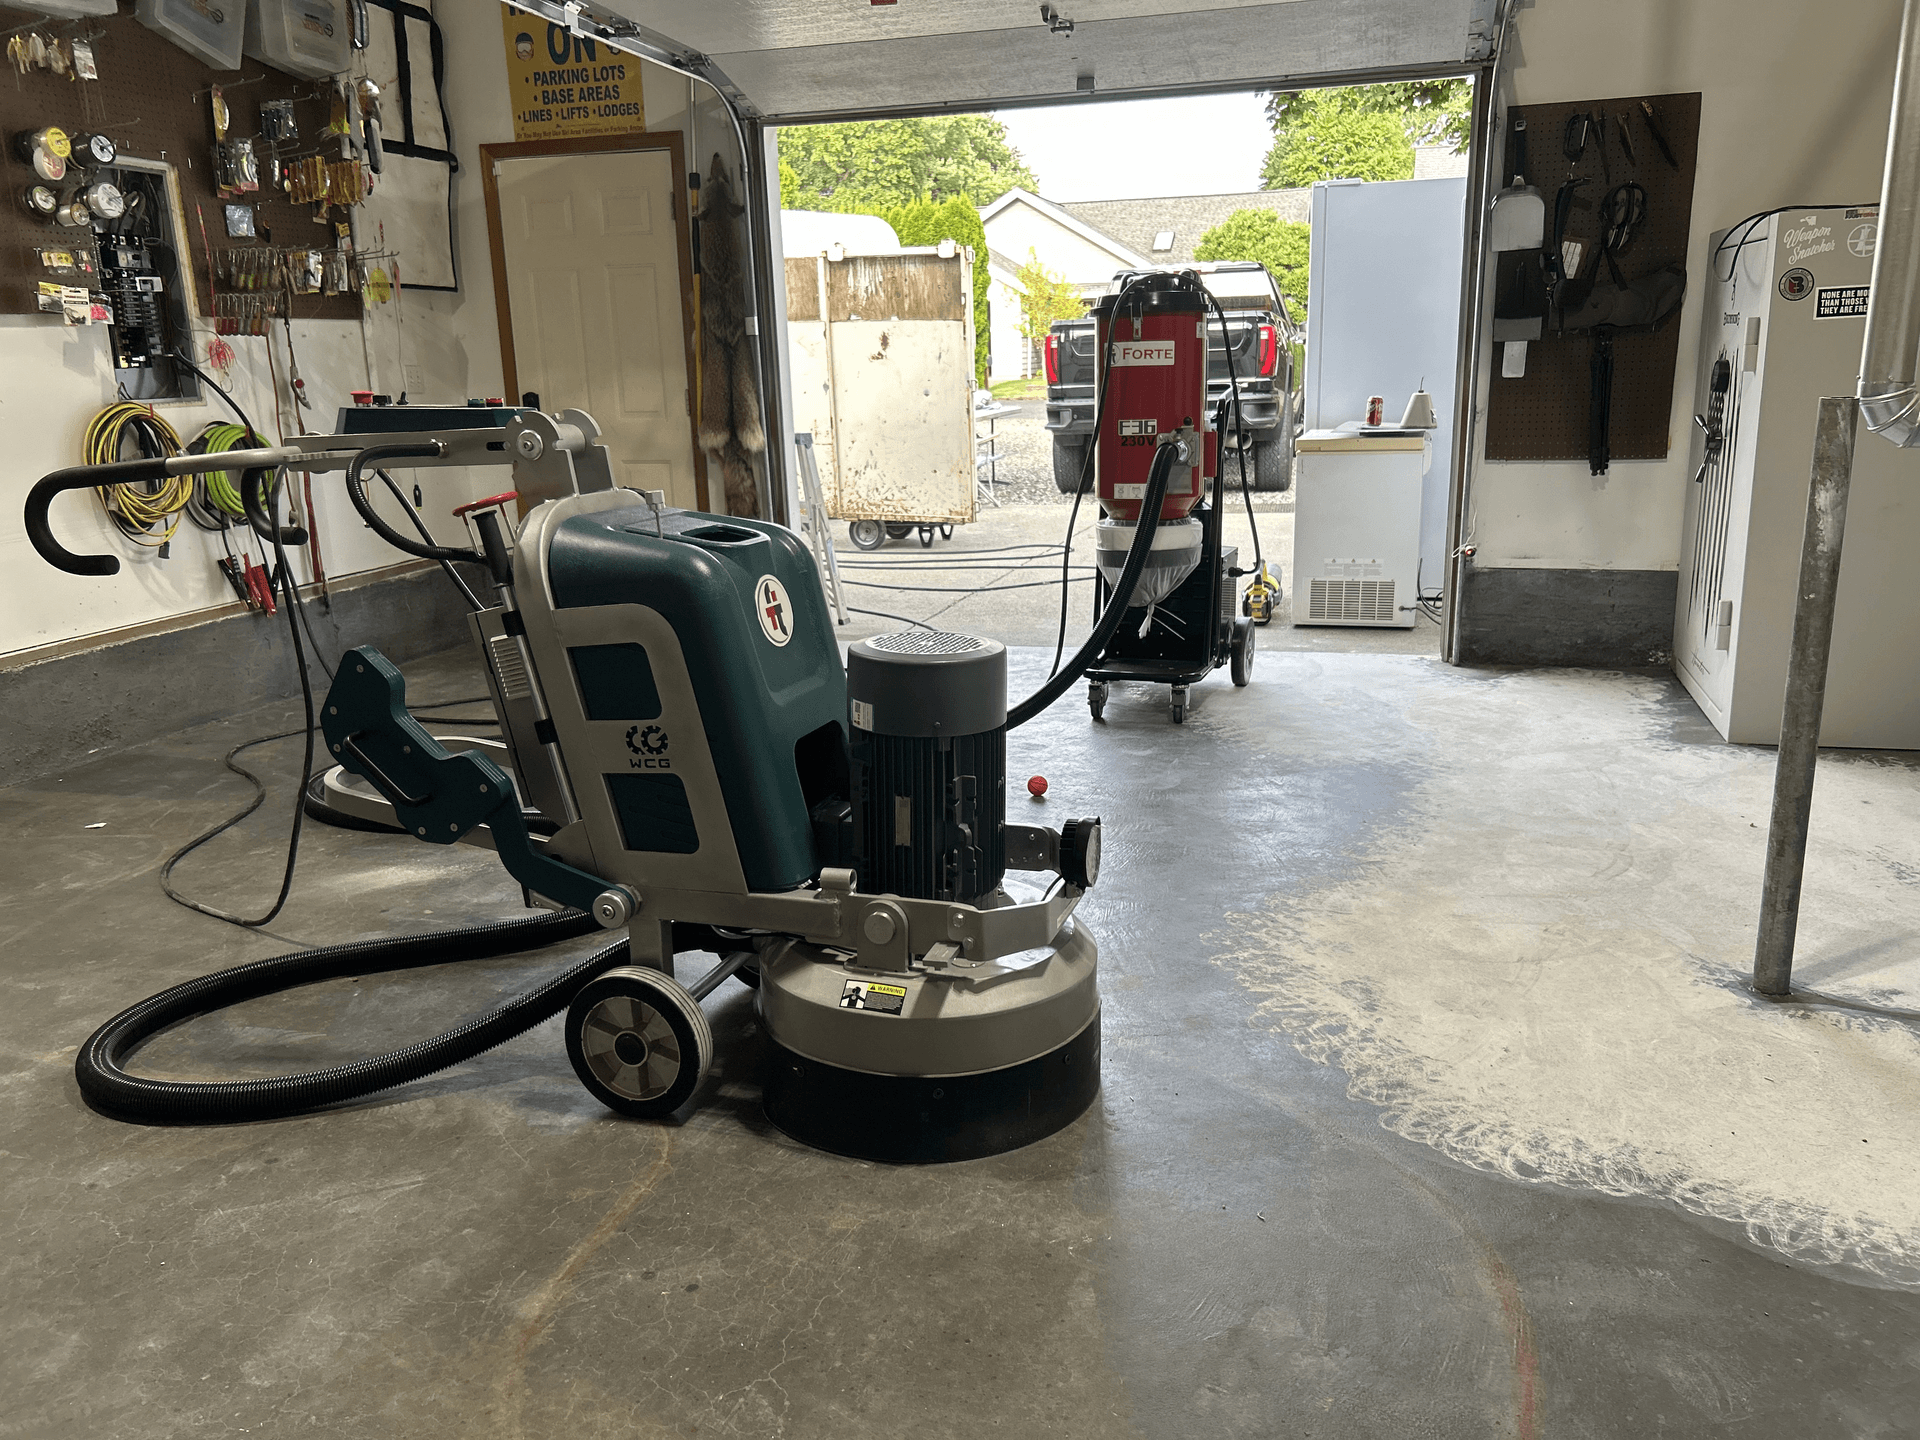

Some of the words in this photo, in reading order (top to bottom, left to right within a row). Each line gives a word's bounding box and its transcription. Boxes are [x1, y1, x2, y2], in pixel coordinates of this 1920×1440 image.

[547, 22, 597, 66] ON
[533, 67, 590, 87] PARKING
[593, 64, 626, 83] LOTS
[541, 88, 575, 105] BASE
[579, 84, 621, 102] AREAS
[523, 109, 553, 123] LINES
[561, 106, 590, 120] LIFTS
[598, 102, 640, 118] LODGES
[1783, 226, 1832, 249] Weapon
[1788, 239, 1836, 265] Snatcher
[1821, 291, 1840, 299] NONE
[1842, 290, 1856, 298] ARE
[1857, 289, 1870, 297] MO
[1820, 299, 1839, 307] THAN
[1841, 298, 1861, 306] THOSE
[1820, 306, 1838, 315] THEY
[1839, 306, 1853, 314] ARE
[1123, 348, 1173, 360] FORTE
[1120, 420, 1156, 435] F36
[1121, 435, 1156, 447] 230V
[629, 758, 671, 769] WCG
[877, 986, 903, 995] WARNING
